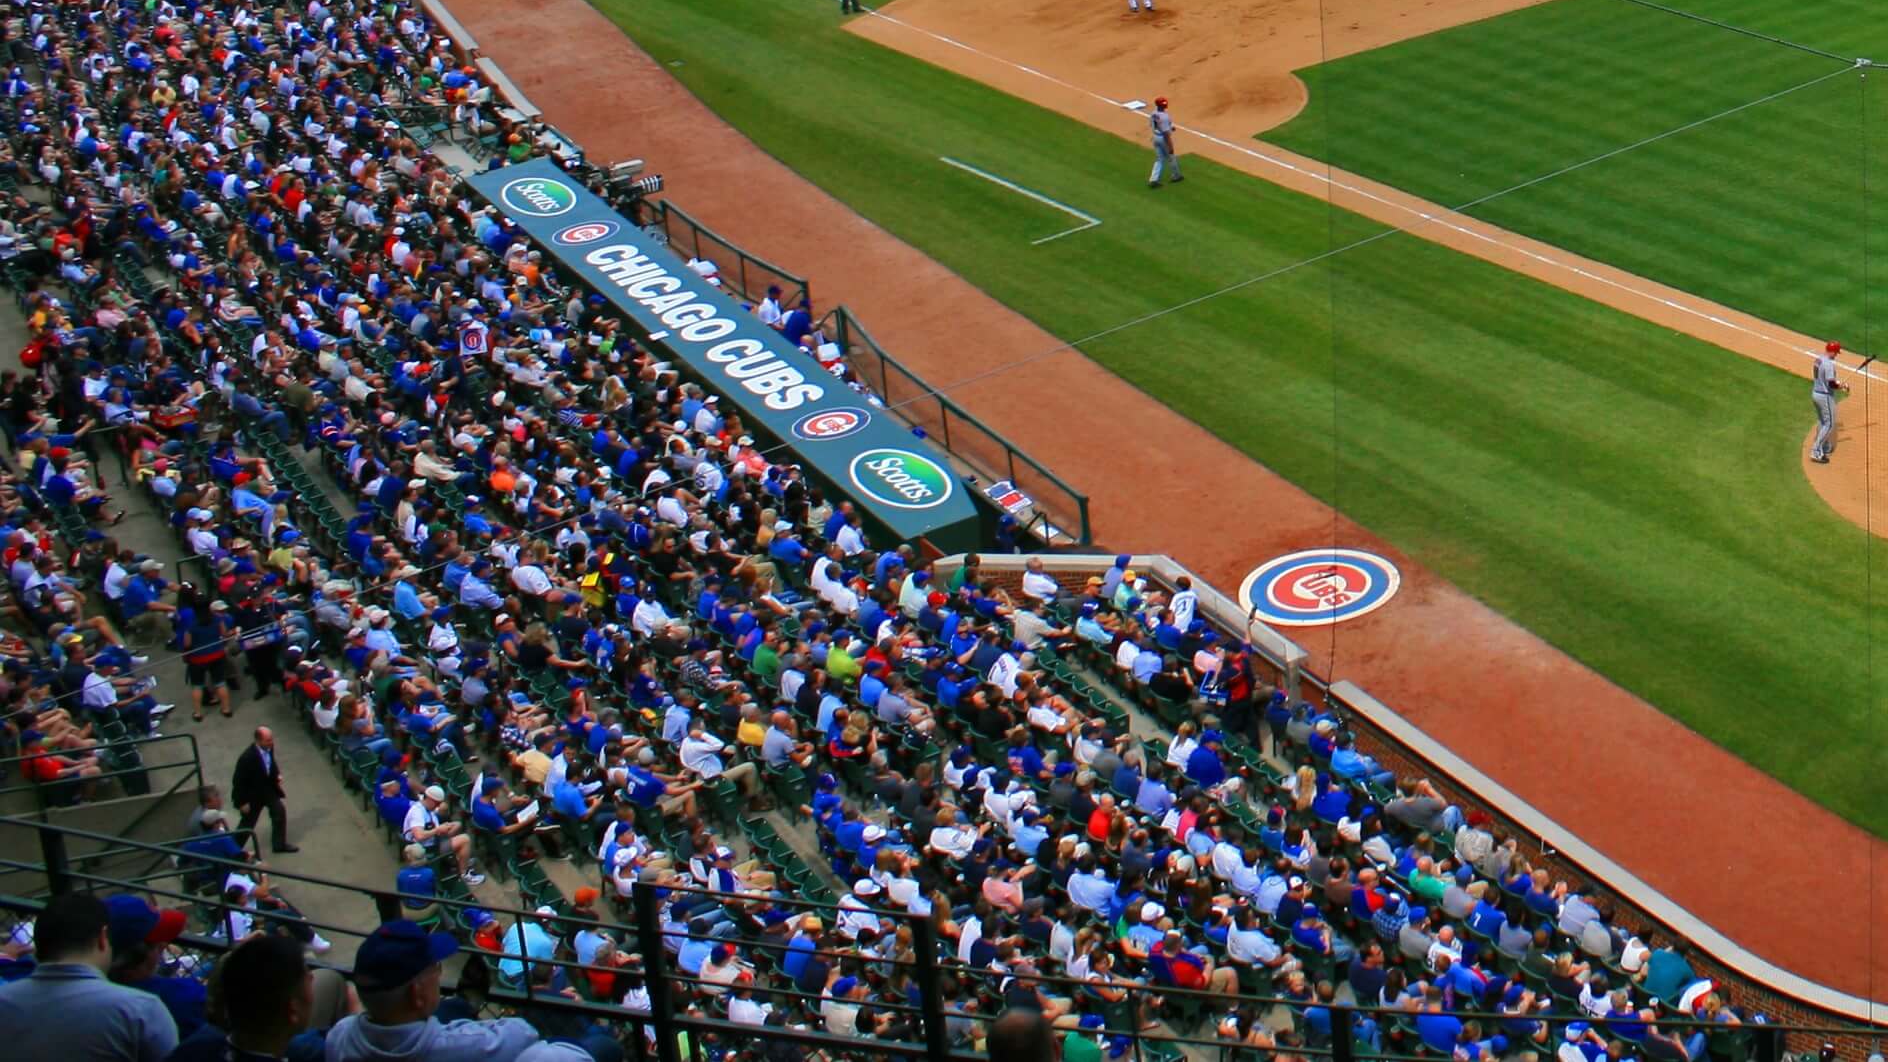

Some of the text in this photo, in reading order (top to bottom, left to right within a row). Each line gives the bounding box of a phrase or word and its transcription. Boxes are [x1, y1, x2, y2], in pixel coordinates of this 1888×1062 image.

[516, 181, 561, 213] Scotts
[586, 244, 737, 342] CHICAGO
[705, 338, 825, 411] CUBS
[865, 457, 933, 504] Scotts
